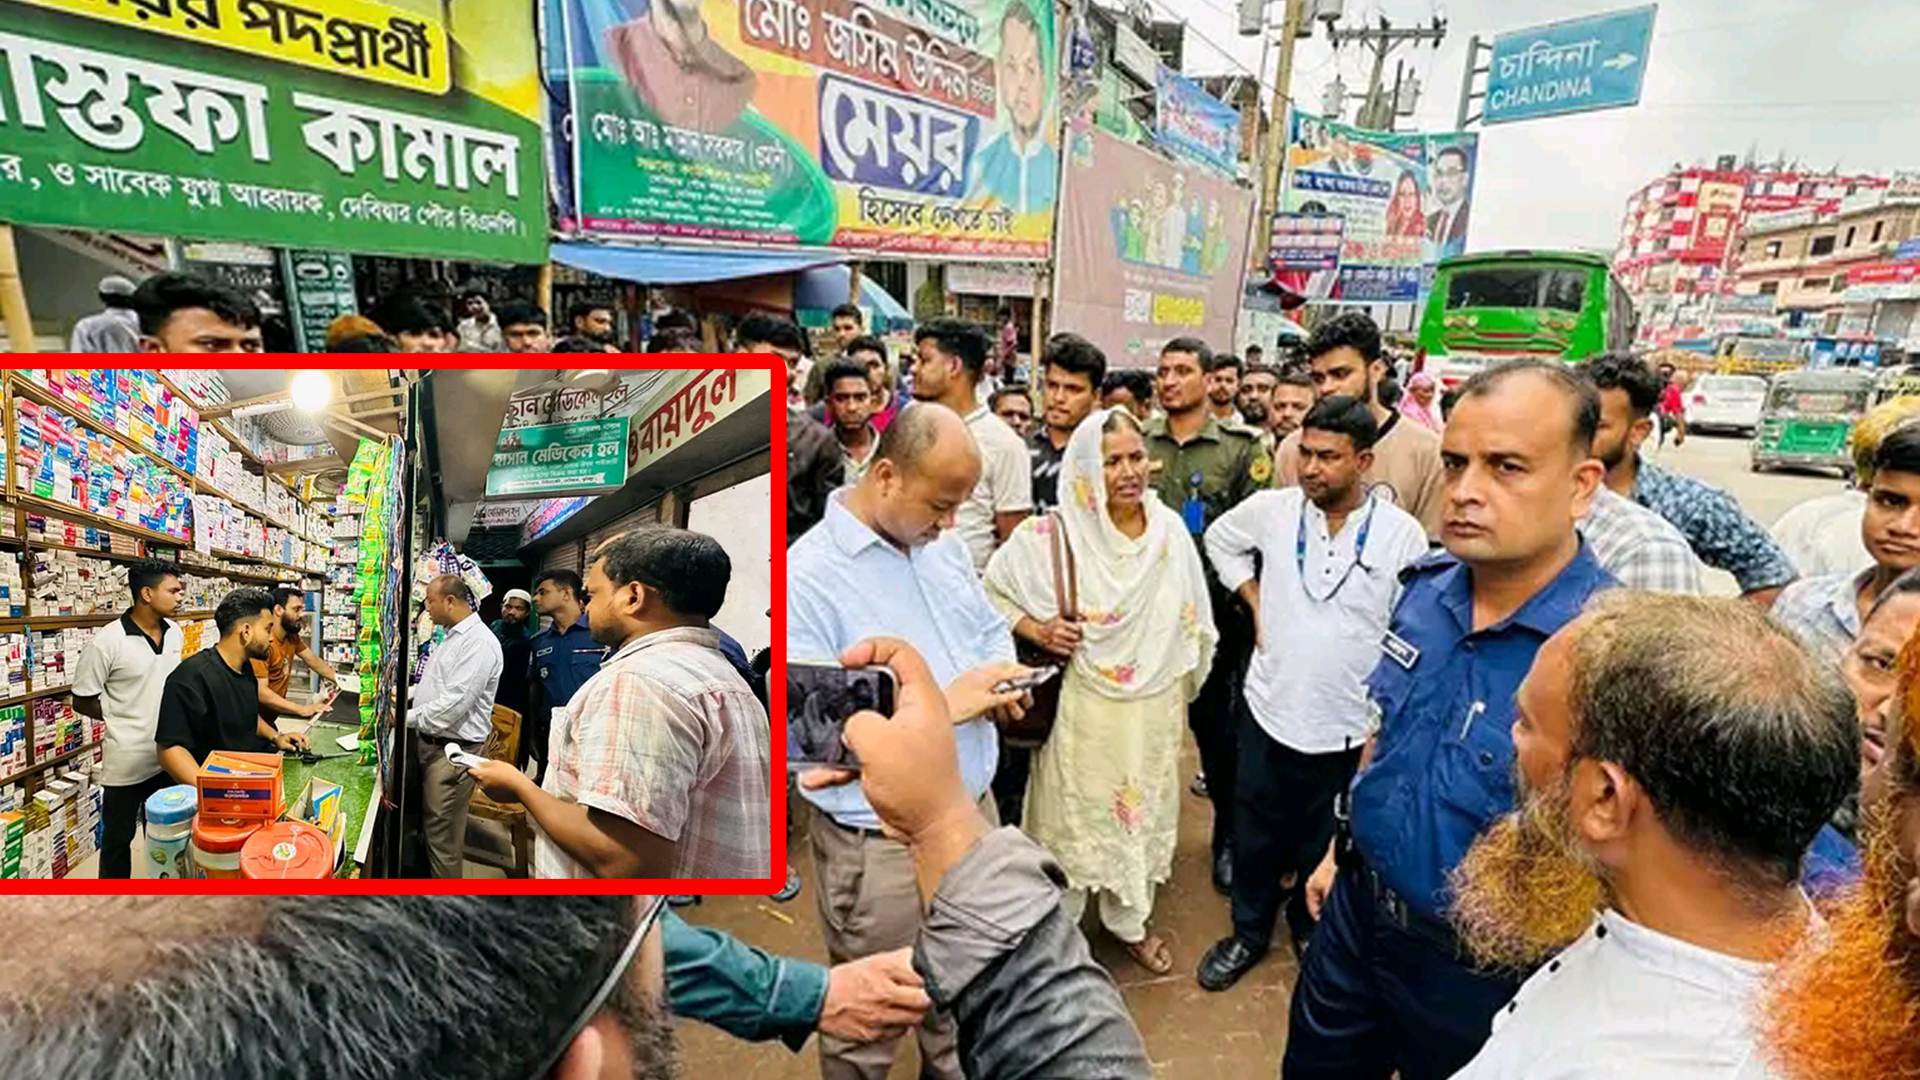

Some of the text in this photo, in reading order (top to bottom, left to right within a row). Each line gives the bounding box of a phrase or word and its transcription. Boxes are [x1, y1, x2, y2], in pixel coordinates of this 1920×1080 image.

[238, 0, 431, 78] পদপ্রার্থী
[744, 0, 811, 50] মোঃ
[821, 7, 900, 81] জসিম
[904, 34, 969, 101] উদ্দিন
[1499, 38, 1601, 78] চান্দিনা
[0, 32, 520, 197] াস্তফা কামাল
[1491, 76, 1593, 110] CHANDINA
[821, 78, 968, 190] মেয়র
[49, 163, 75, 185] ও
[79, 163, 172, 197] সাবেক
[178, 176, 222, 210] যুগ্ম
[416, 201, 456, 229] পৌর
[858, 186, 925, 226] হিসেবে
[931, 206, 983, 232] দেখতে
[494, 452, 528, 467] হাসান
[532, 442, 593, 465] মেডিকেল
[597, 441, 620, 457] হল
[628, 369, 736, 468] ওবায়দুল
